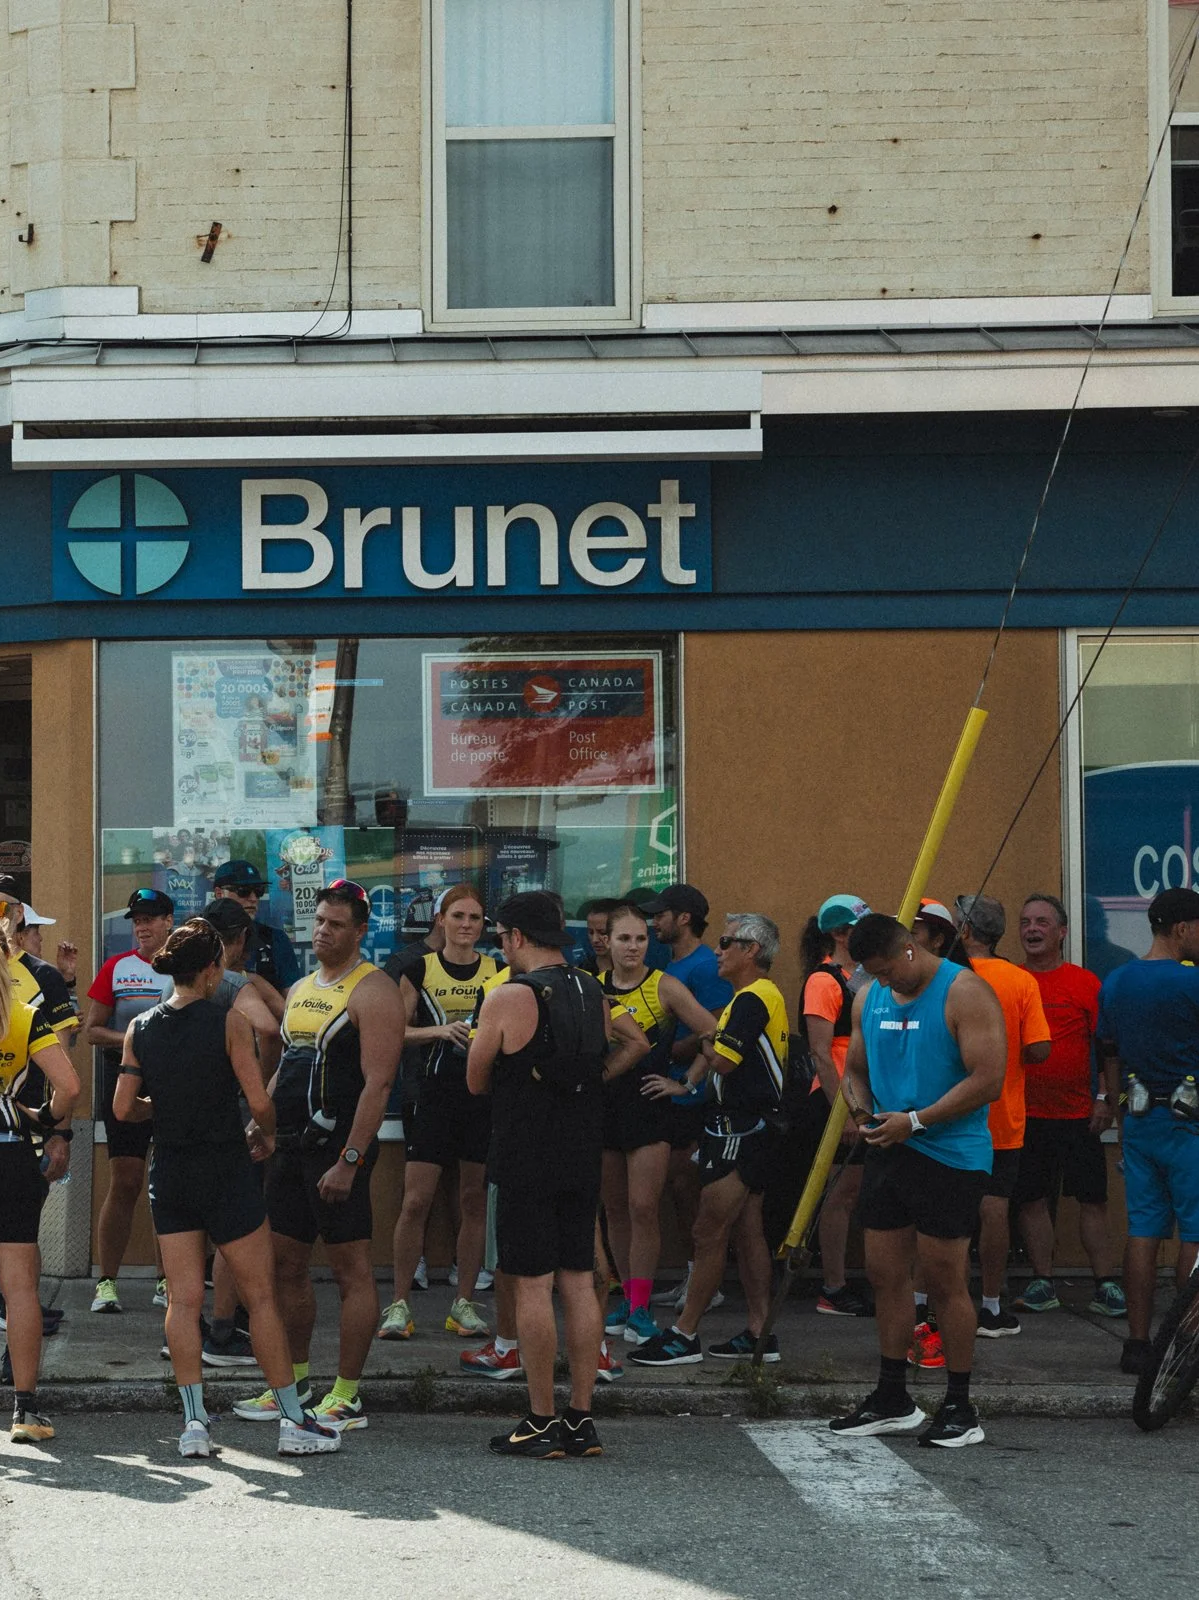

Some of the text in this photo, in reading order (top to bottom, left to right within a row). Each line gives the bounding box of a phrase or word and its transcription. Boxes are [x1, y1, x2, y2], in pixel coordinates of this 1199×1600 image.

[241, 478, 697, 590] Brunet
[450, 678, 509, 689] POSTES
[568, 676, 635, 688] CANADA
[451, 701, 517, 712] CANADA
[568, 700, 608, 711] POST
[451, 732, 496, 745] Bureau
[569, 731, 596, 744] Post
[451, 749, 506, 765] de poste
[569, 748, 608, 761] Office
[1133, 845, 1199, 899] CO
[435, 986, 477, 997] la foul
[301, 999, 333, 1011] foulée
